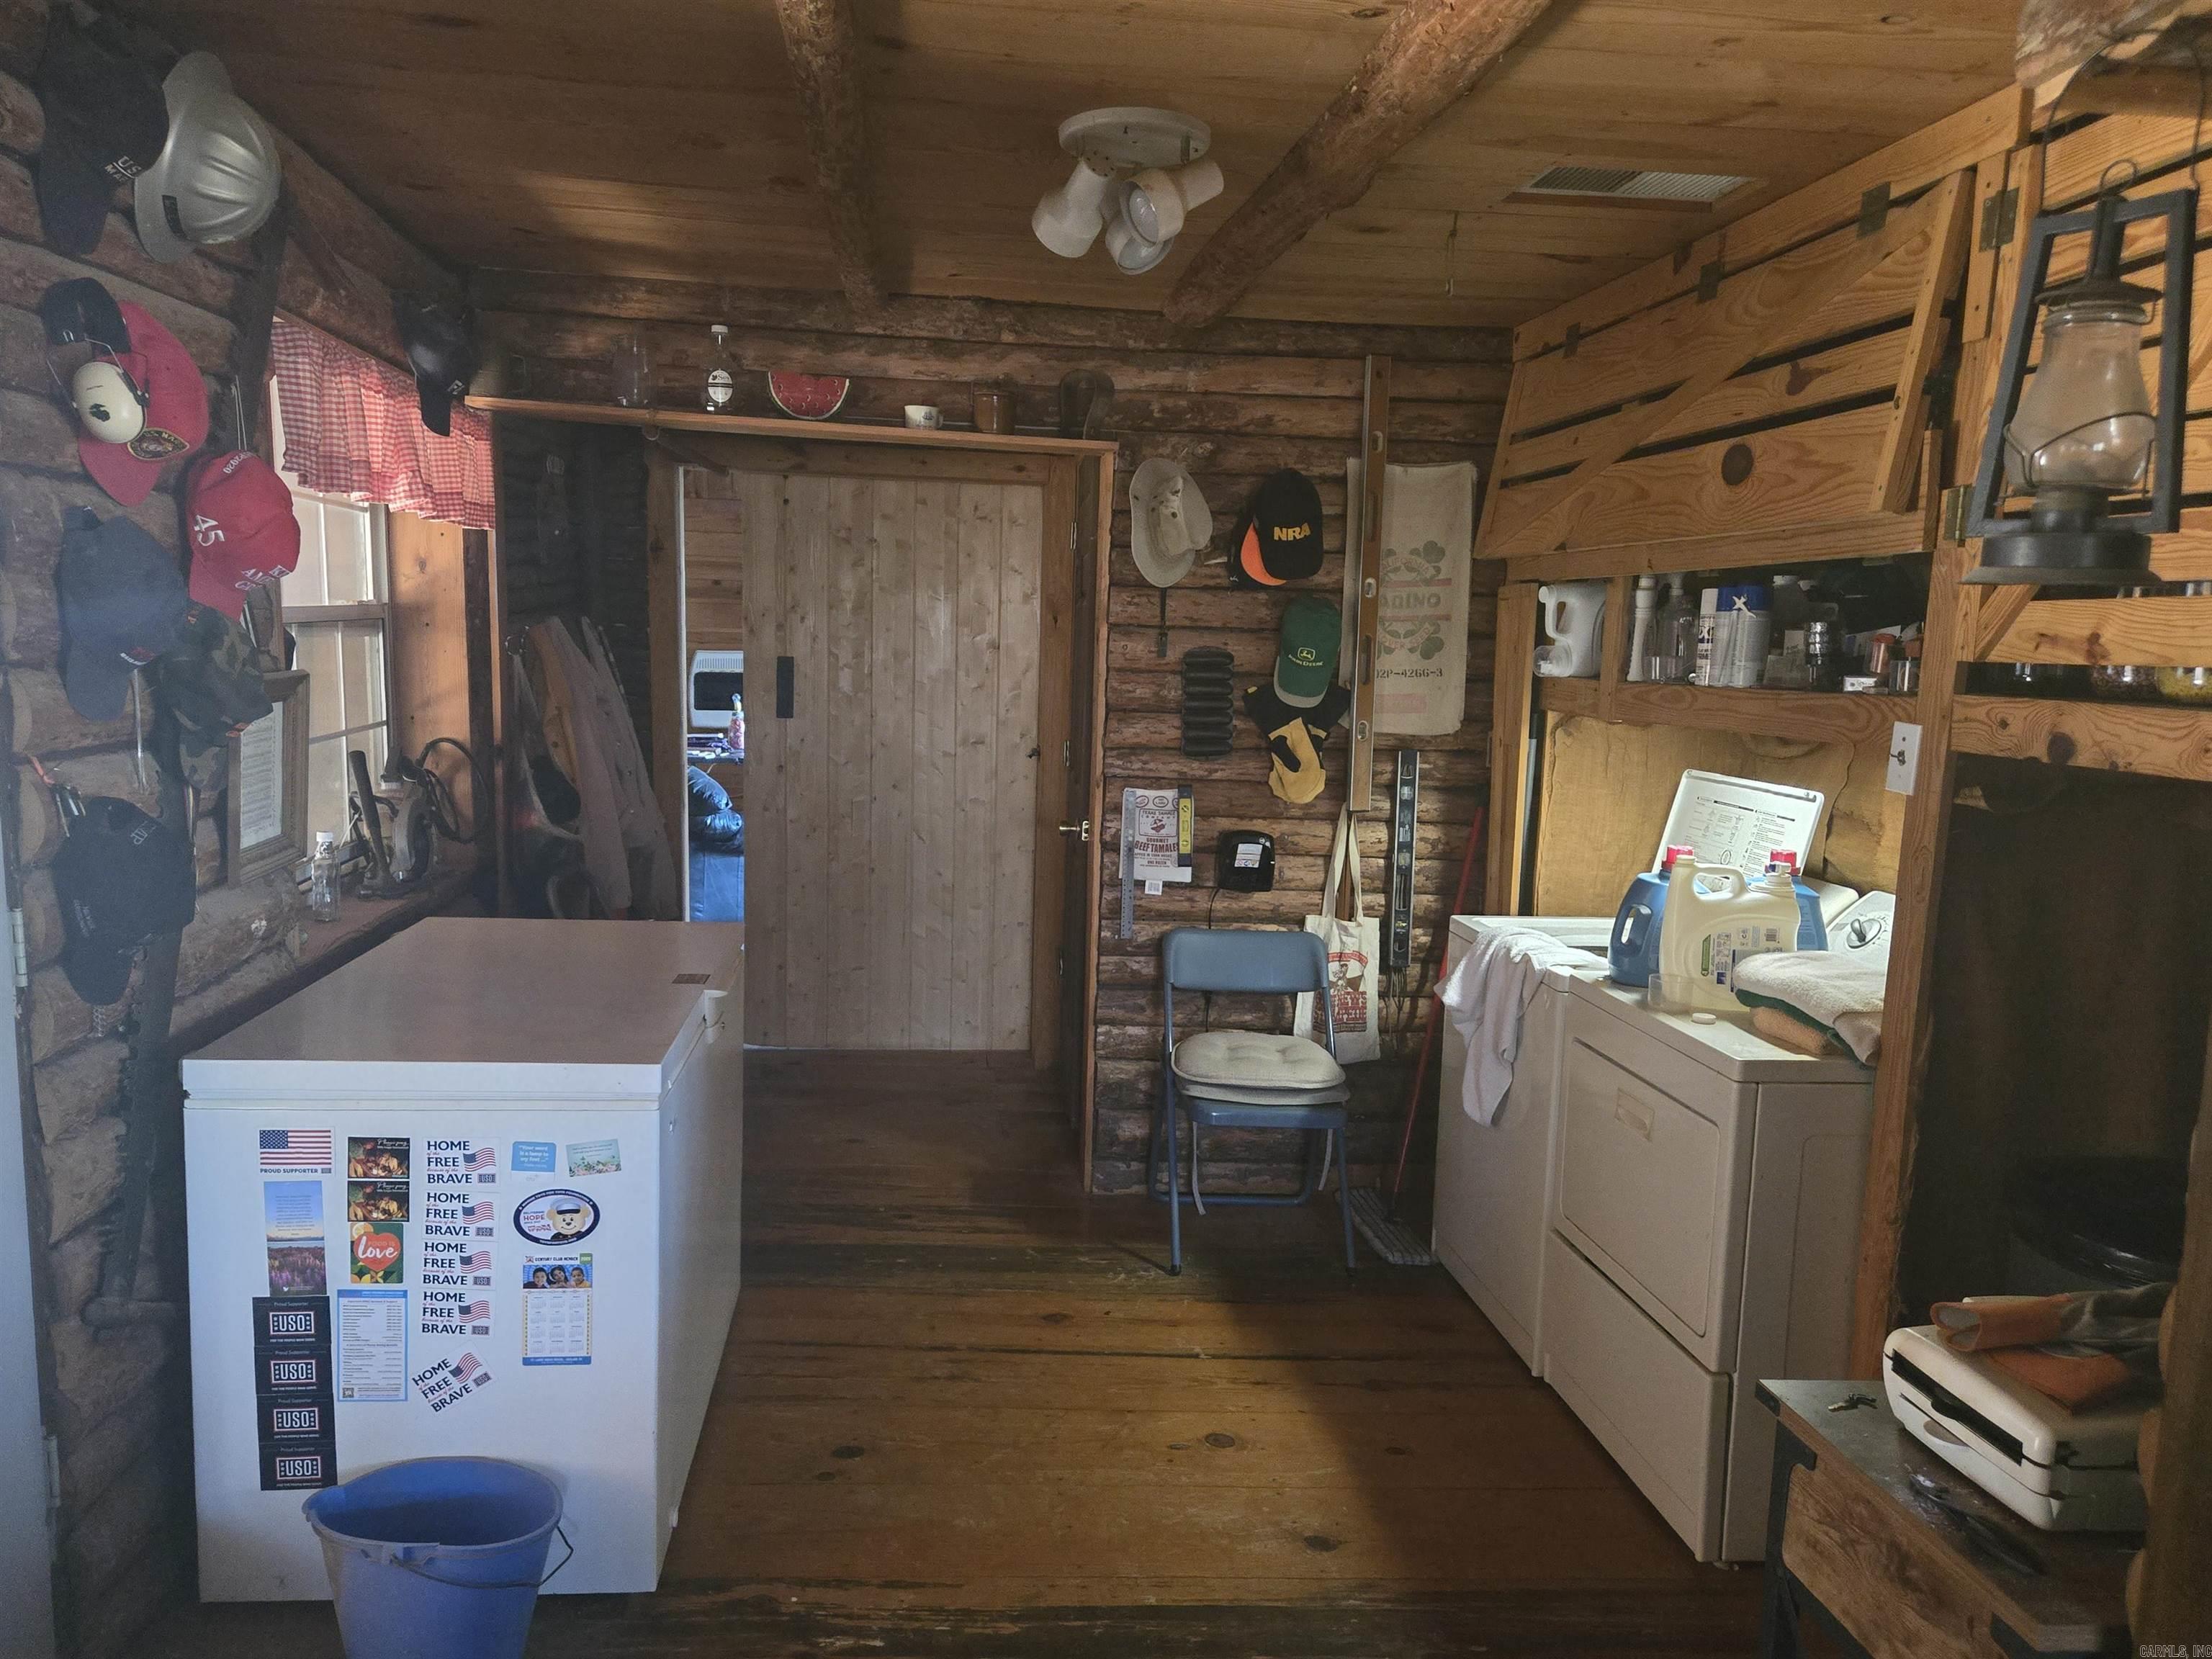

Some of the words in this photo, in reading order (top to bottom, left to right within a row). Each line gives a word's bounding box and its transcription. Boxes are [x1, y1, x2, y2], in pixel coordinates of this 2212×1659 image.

[194, 514, 225, 547] 45
[1274, 522, 1311, 541] NRA
[1379, 592, 1441, 608] ADINO
[1135, 840, 1150, 852] BEEF
[427, 1141, 470, 1151] HOME
[427, 1157, 459, 1167] FREE
[427, 1174, 472, 1184] BRAVE
[427, 1192, 469, 1203] HOME
[426, 1208, 458, 1219] FREE
[425, 1225, 470, 1236] BRAVE
[358, 1236, 397, 1259] love
[424, 1242, 467, 1253] HOME
[424, 1258, 455, 1268] FREE
[423, 1274, 467, 1285] BRAVE
[423, 1291, 465, 1303] HOME
[423, 1307, 454, 1318] FREE
[279, 1315, 305, 1331] USO
[422, 1323, 467, 1334] BRAVE
[280, 1363, 306, 1380] USO
[412, 1358, 451, 1386] HOME
[421, 1377, 452, 1399] FREE
[431, 1383, 472, 1412] BRAVE
[283, 1412, 310, 1428] USO
[286, 1460, 312, 1476] USO
